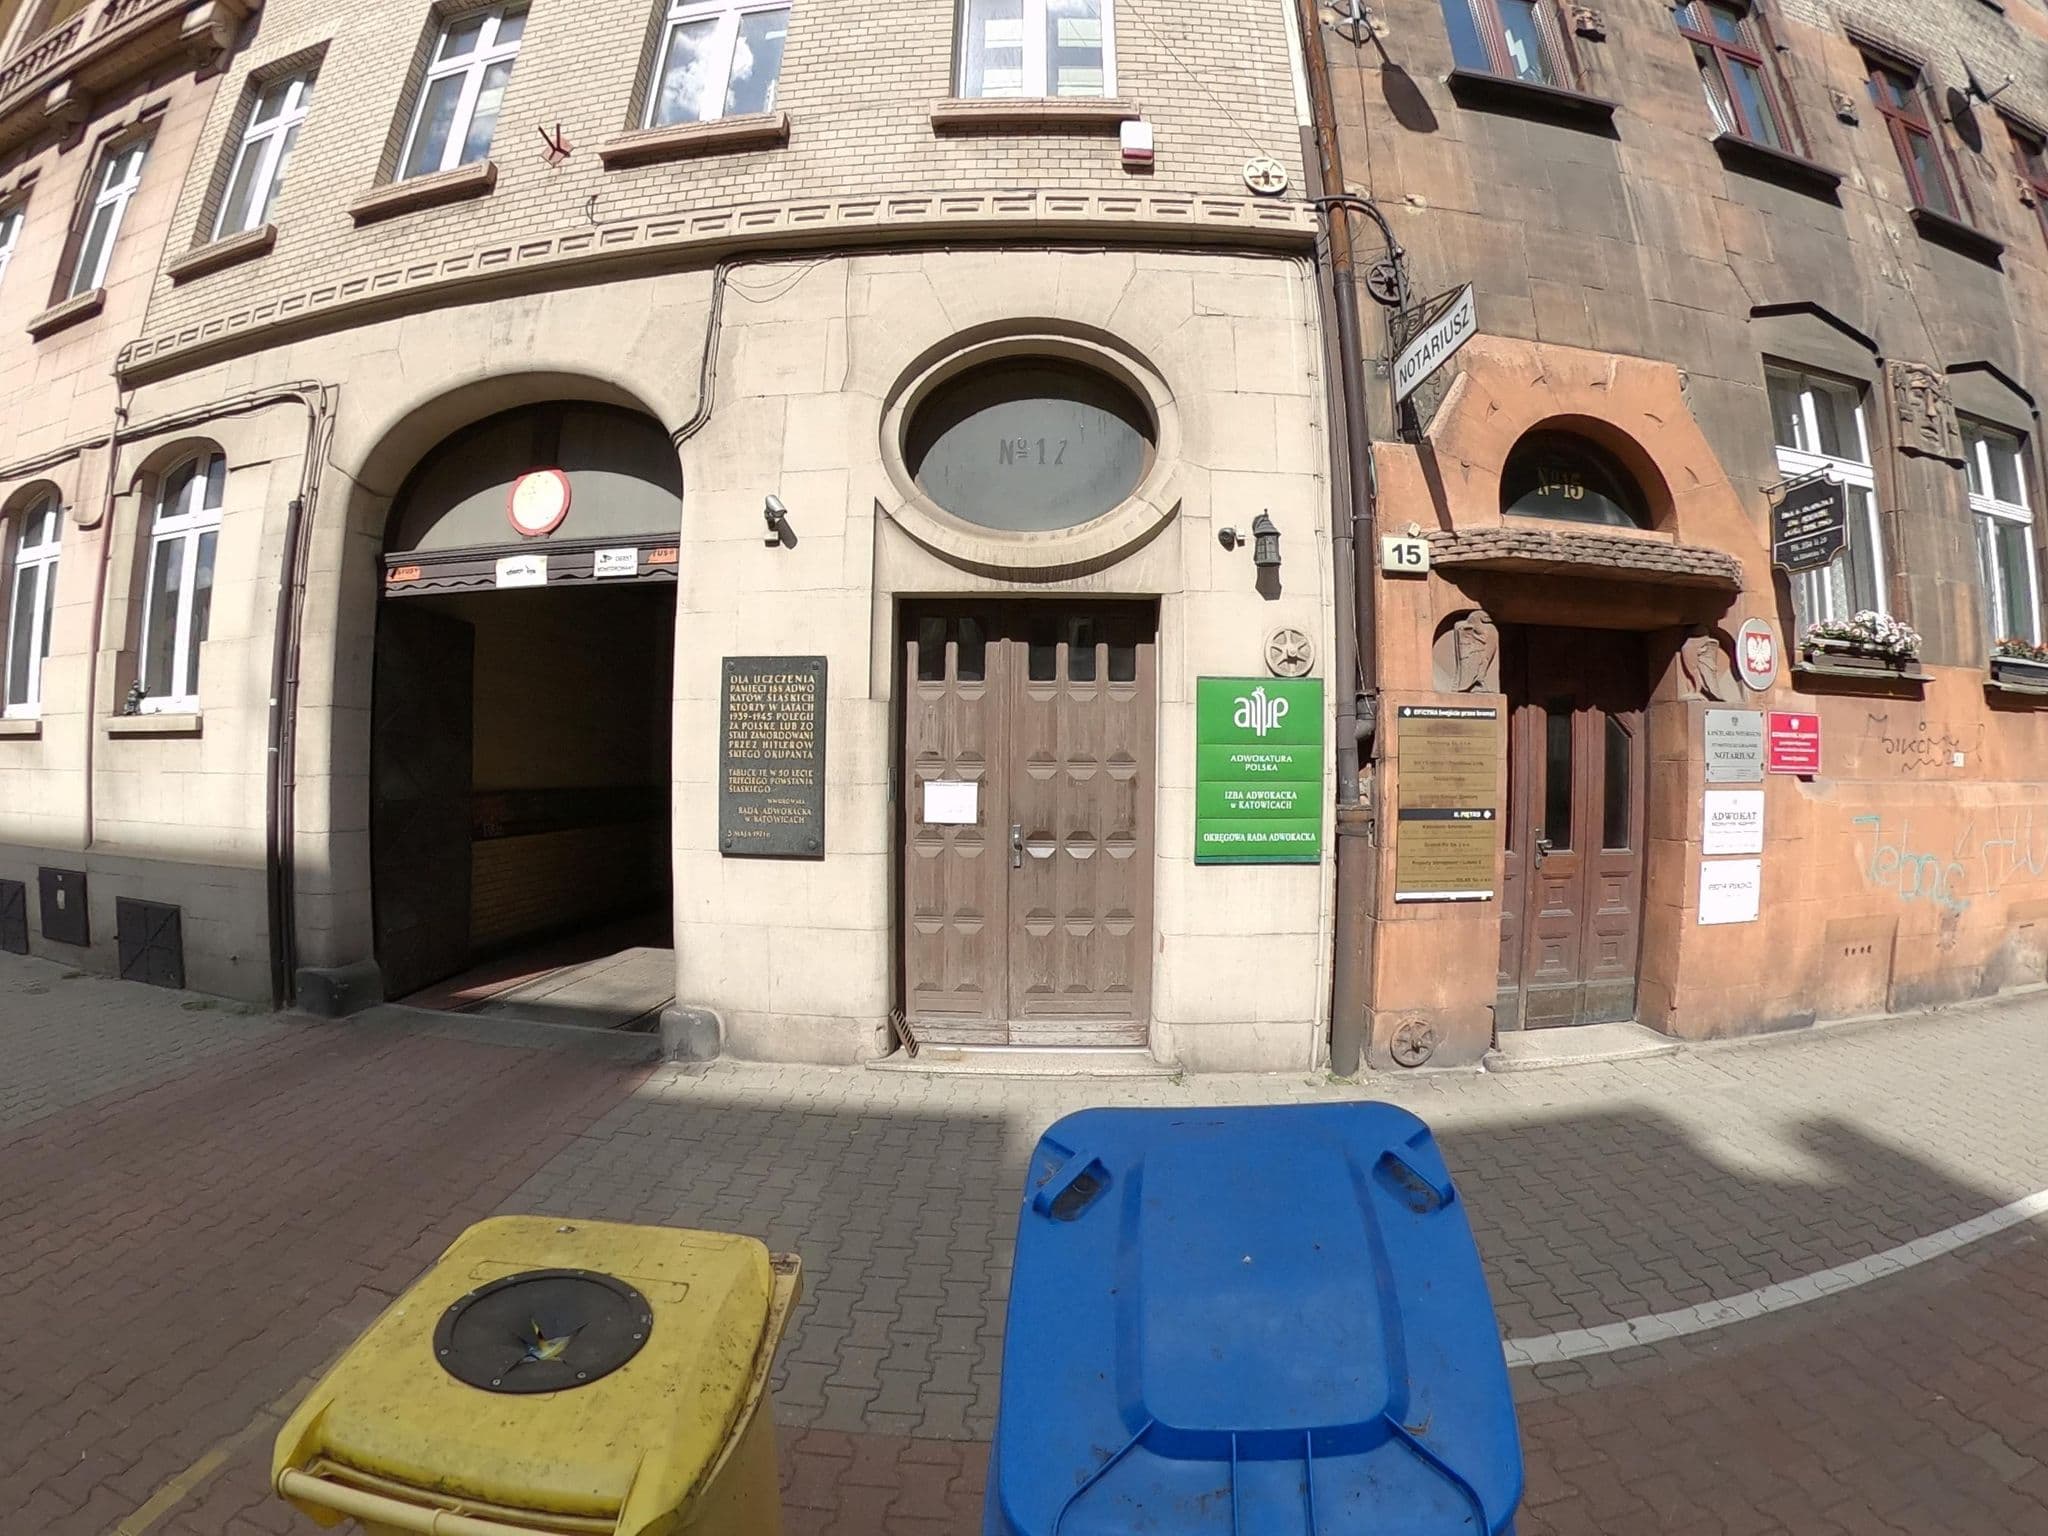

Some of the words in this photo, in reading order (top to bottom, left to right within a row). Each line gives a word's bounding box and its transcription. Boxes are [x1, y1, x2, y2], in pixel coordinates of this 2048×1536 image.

[1399, 303, 1470, 388] NOTARIUSZ
[1036, 438, 1067, 465] 17
[1392, 543, 1421, 565] 15
[730, 674, 749, 684] DLA
[753, 674, 815, 684] UCZCZENIA
[769, 703, 778, 711] W
[781, 703, 814, 712] LATACH
[729, 712, 773, 721] 1939-1945
[729, 722, 739, 730] ZA
[780, 722, 797, 731] LUB
[750, 731, 814, 740] ZAMORDOWANI
[729, 740, 757, 749] PRZEZ
[728, 749, 760, 759] SKIEGO
[764, 749, 814, 759] OKUPANTA
[1230, 754, 1293, 763] ADWOKATURA
[1713, 751, 1756, 760] NOTARIUSZ
[1245, 763, 1278, 771] POLSKA
[791, 769, 813, 777] LECIE
[728, 777, 768, 785] TRZECIEGO
[770, 777, 814, 785] POWSTANIA
[1224, 791, 1244, 800] IZBA
[1246, 791, 1297, 800] ADWOKACKA
[1239, 800, 1292, 809] KATOWICACH
[738, 806, 759, 815] RADA
[762, 806, 812, 816] ADWOKACKA
[753, 815, 805, 824] KATOWICACH
[1711, 811, 1757, 821] ADWOKAT
[1203, 833, 1245, 843] OKRĘGOWA
[1247, 833, 1267, 842] RADA
[1269, 832, 1316, 842] ADWOKACKA
